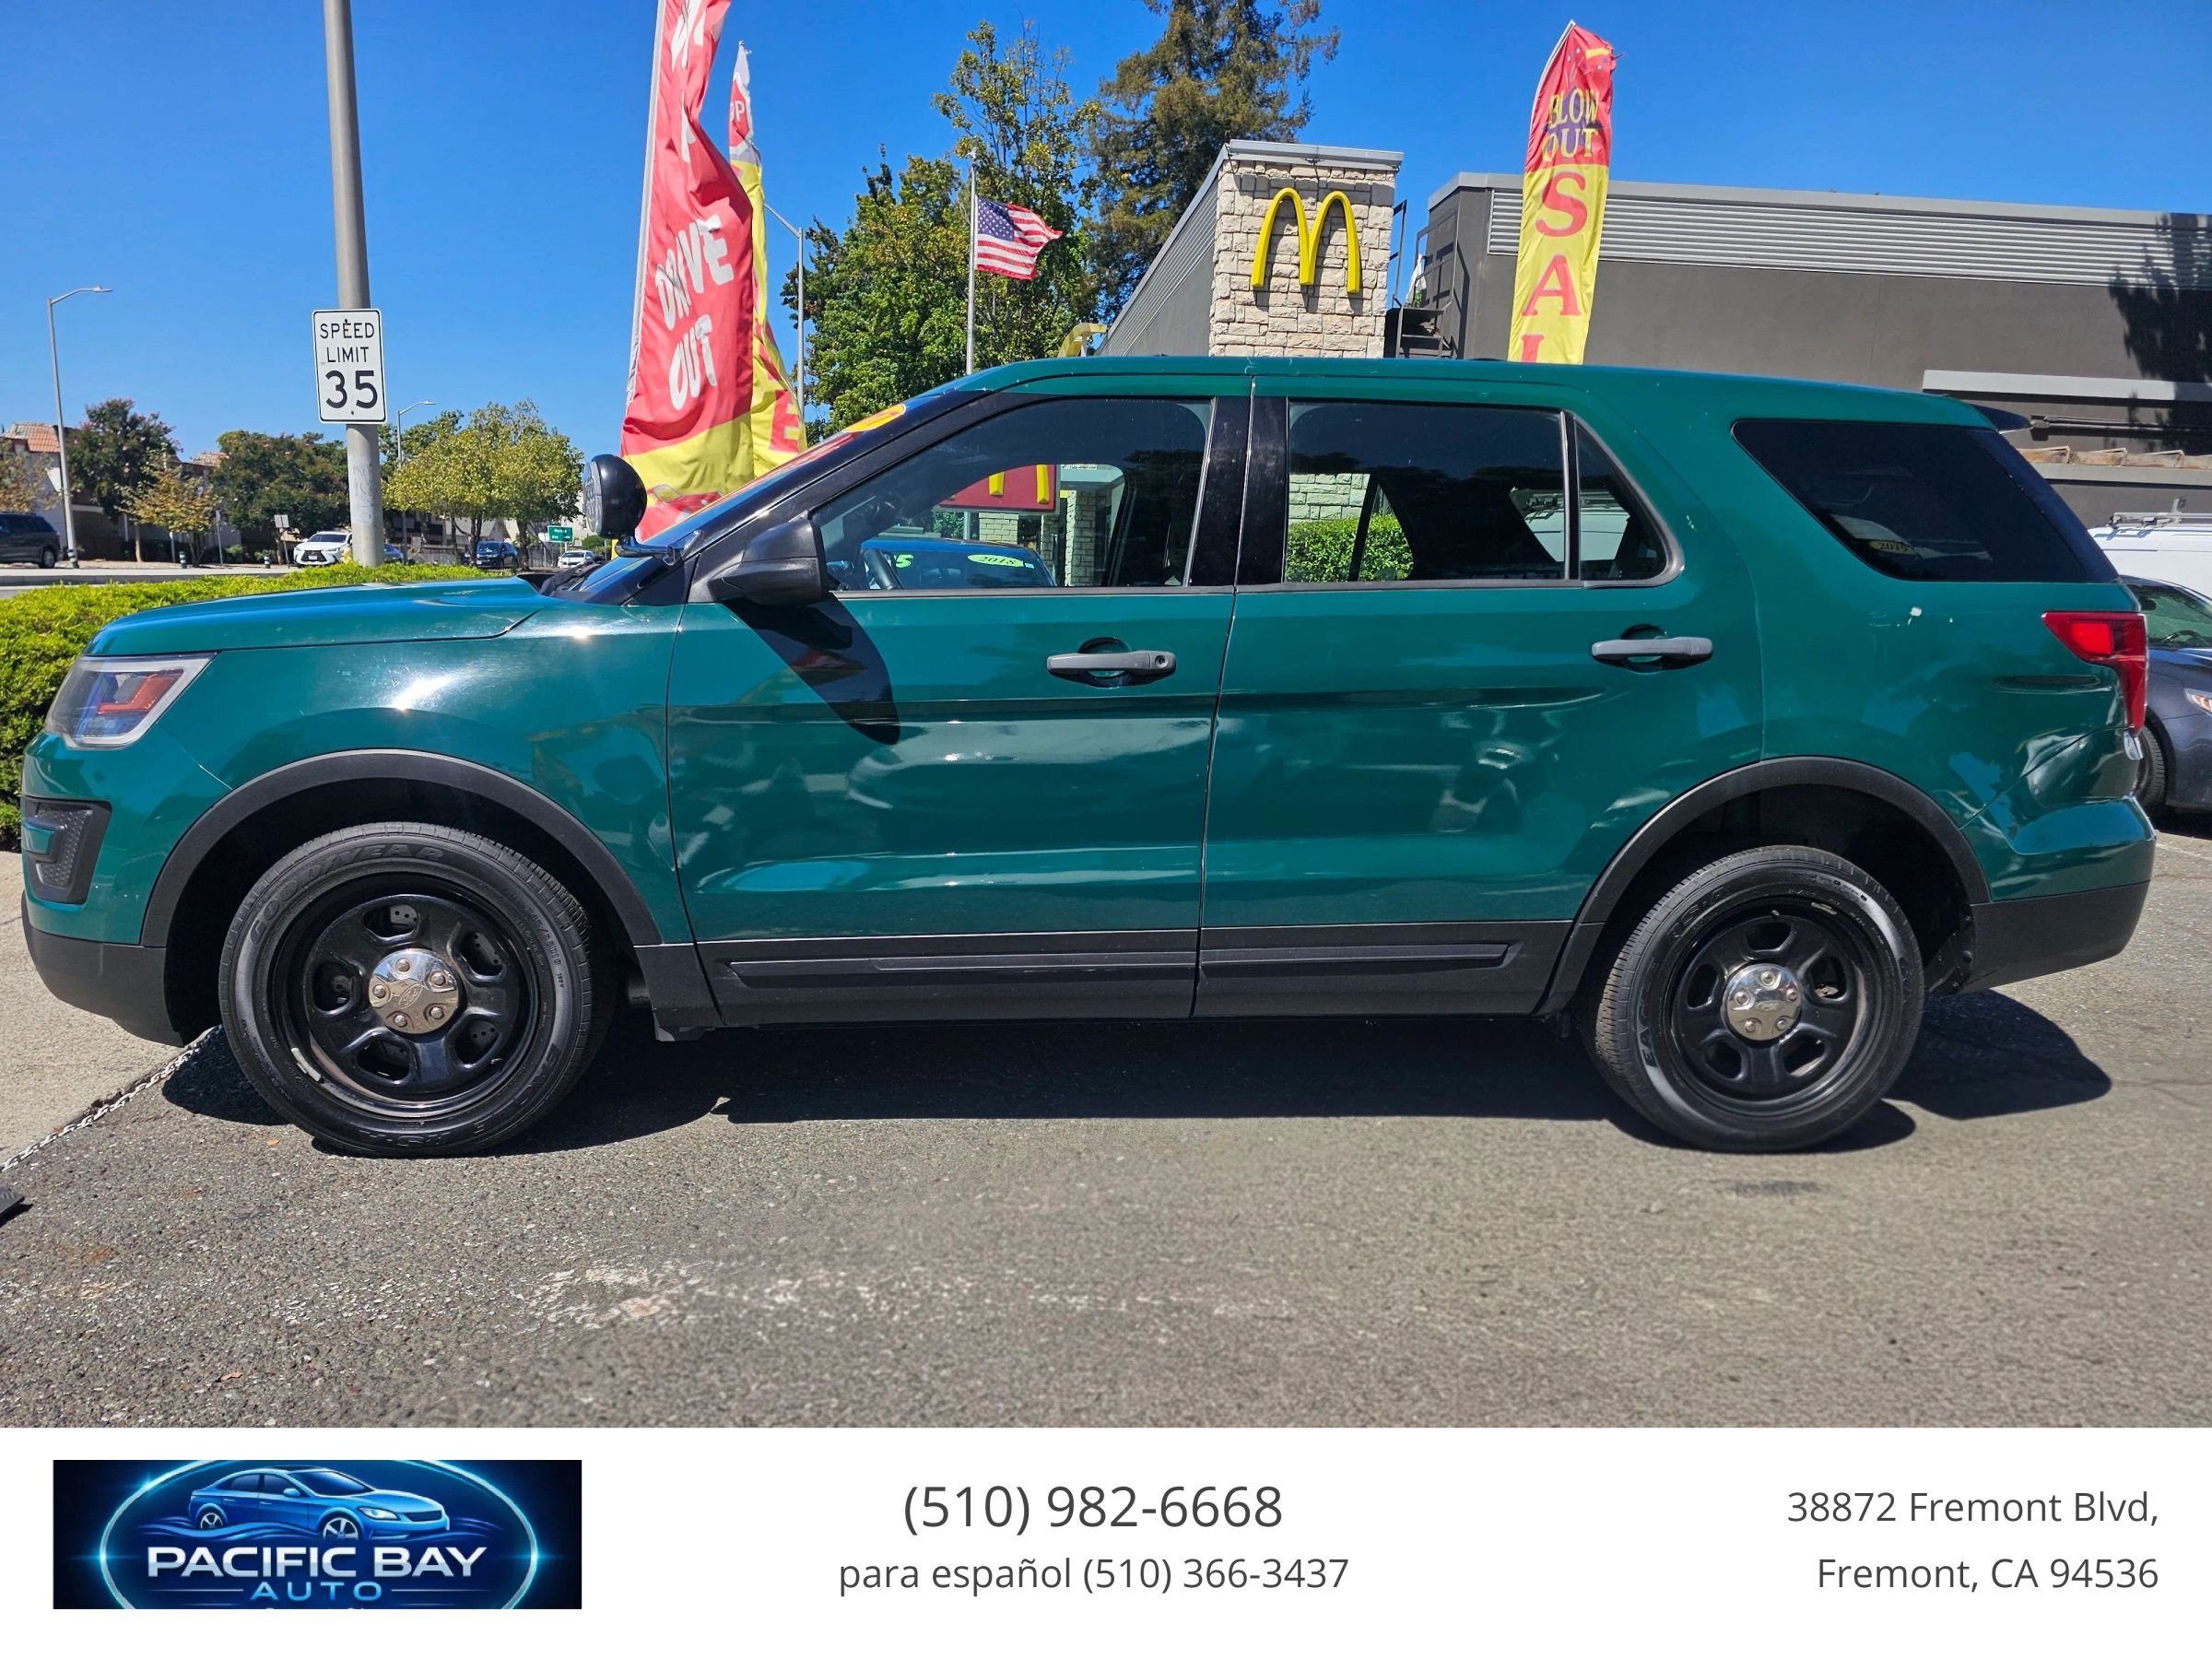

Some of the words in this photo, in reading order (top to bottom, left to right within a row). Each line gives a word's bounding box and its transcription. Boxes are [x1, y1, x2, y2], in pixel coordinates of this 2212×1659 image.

[1548, 88, 1600, 129] BLOW
[1542, 127, 1599, 162] OUT
[655, 214, 735, 330] DRIVE
[320, 322, 375, 339] SPEED
[326, 347, 370, 363] LIMIT
[669, 314, 717, 410] OUT
[324, 370, 378, 409] 35
[980, 555, 1017, 566] 2018
[250, 843, 445, 944] GOODYEAR
